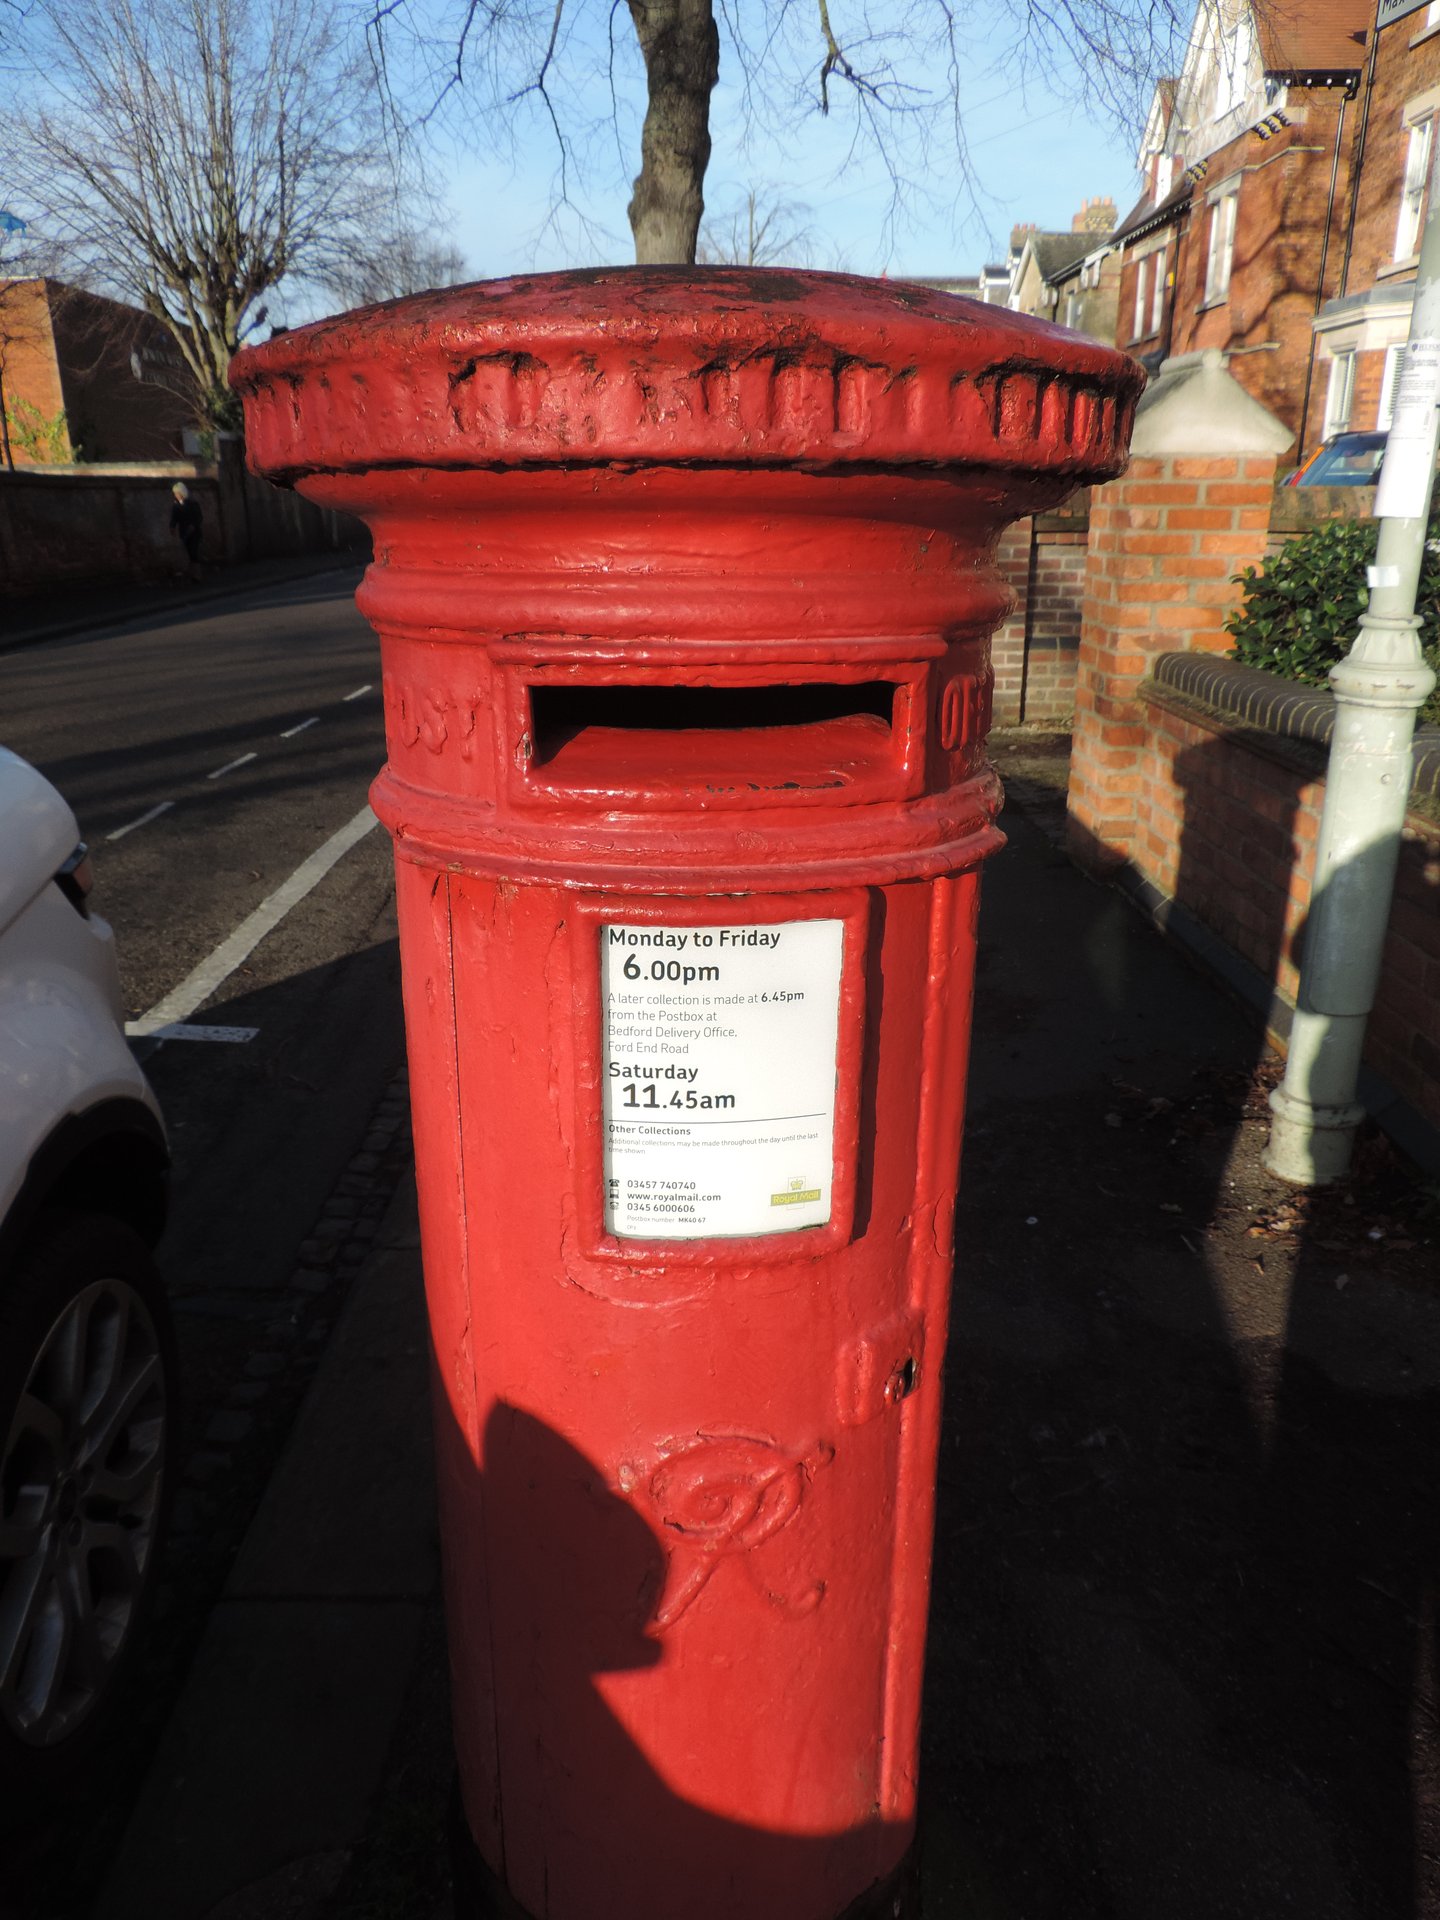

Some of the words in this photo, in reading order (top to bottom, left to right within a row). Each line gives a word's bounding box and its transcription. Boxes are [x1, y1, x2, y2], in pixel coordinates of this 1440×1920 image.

[609, 928, 688, 950] Monday
[693, 931, 713, 947] to
[719, 930, 781, 949] Friday
[623, 953, 720, 985] 6.00pm
[607, 993, 616, 1003] A
[618, 993, 644, 1005] later
[647, 994, 700, 1005] collection
[702, 994, 711, 1005] is
[714, 993, 745, 1005] made
[747, 993, 759, 1004] at
[761, 991, 805, 1003] 6.45pm
[607, 1009, 635, 1020] from
[637, 1010, 656, 1021] the
[659, 1010, 704, 1022] Postbox
[706, 1012, 717, 1022] at
[608, 1025, 652, 1037] Bedford
[656, 1026, 701, 1039] Delivery
[608, 1041, 633, 1053] Ford
[636, 1041, 658, 1054] End
[661, 1043, 689, 1054] Road
[609, 1062, 699, 1082] Saturday
[623, 1083, 736, 1109] 11.45am
[609, 1124, 636, 1134] Other
[638, 1126, 691, 1136] Collections
[608, 1137, 640, 1146] Additional
[641, 1139, 676, 1147] collections
[692, 1139, 701, 1147] be
[701, 1139, 720, 1147] made
[721, 1138, 757, 1147] throughout
[758, 1137, 769, 1145] the
[769, 1136, 782, 1145] day
[781, 1135, 796, 1143] until
[796, 1134, 807, 1142] the
[807, 1132, 818, 1140] last
[624, 1147, 646, 1155] shown
[627, 1180, 657, 1189] 03457
[660, 1181, 696, 1190] 740740
[627, 1192, 721, 1202] www.royalmail.com
[773, 1193, 798, 1204] Royal
[799, 1190, 819, 1201] Mail
[627, 1203, 651, 1211] 0345
[653, 1204, 695, 1213] 6000606
